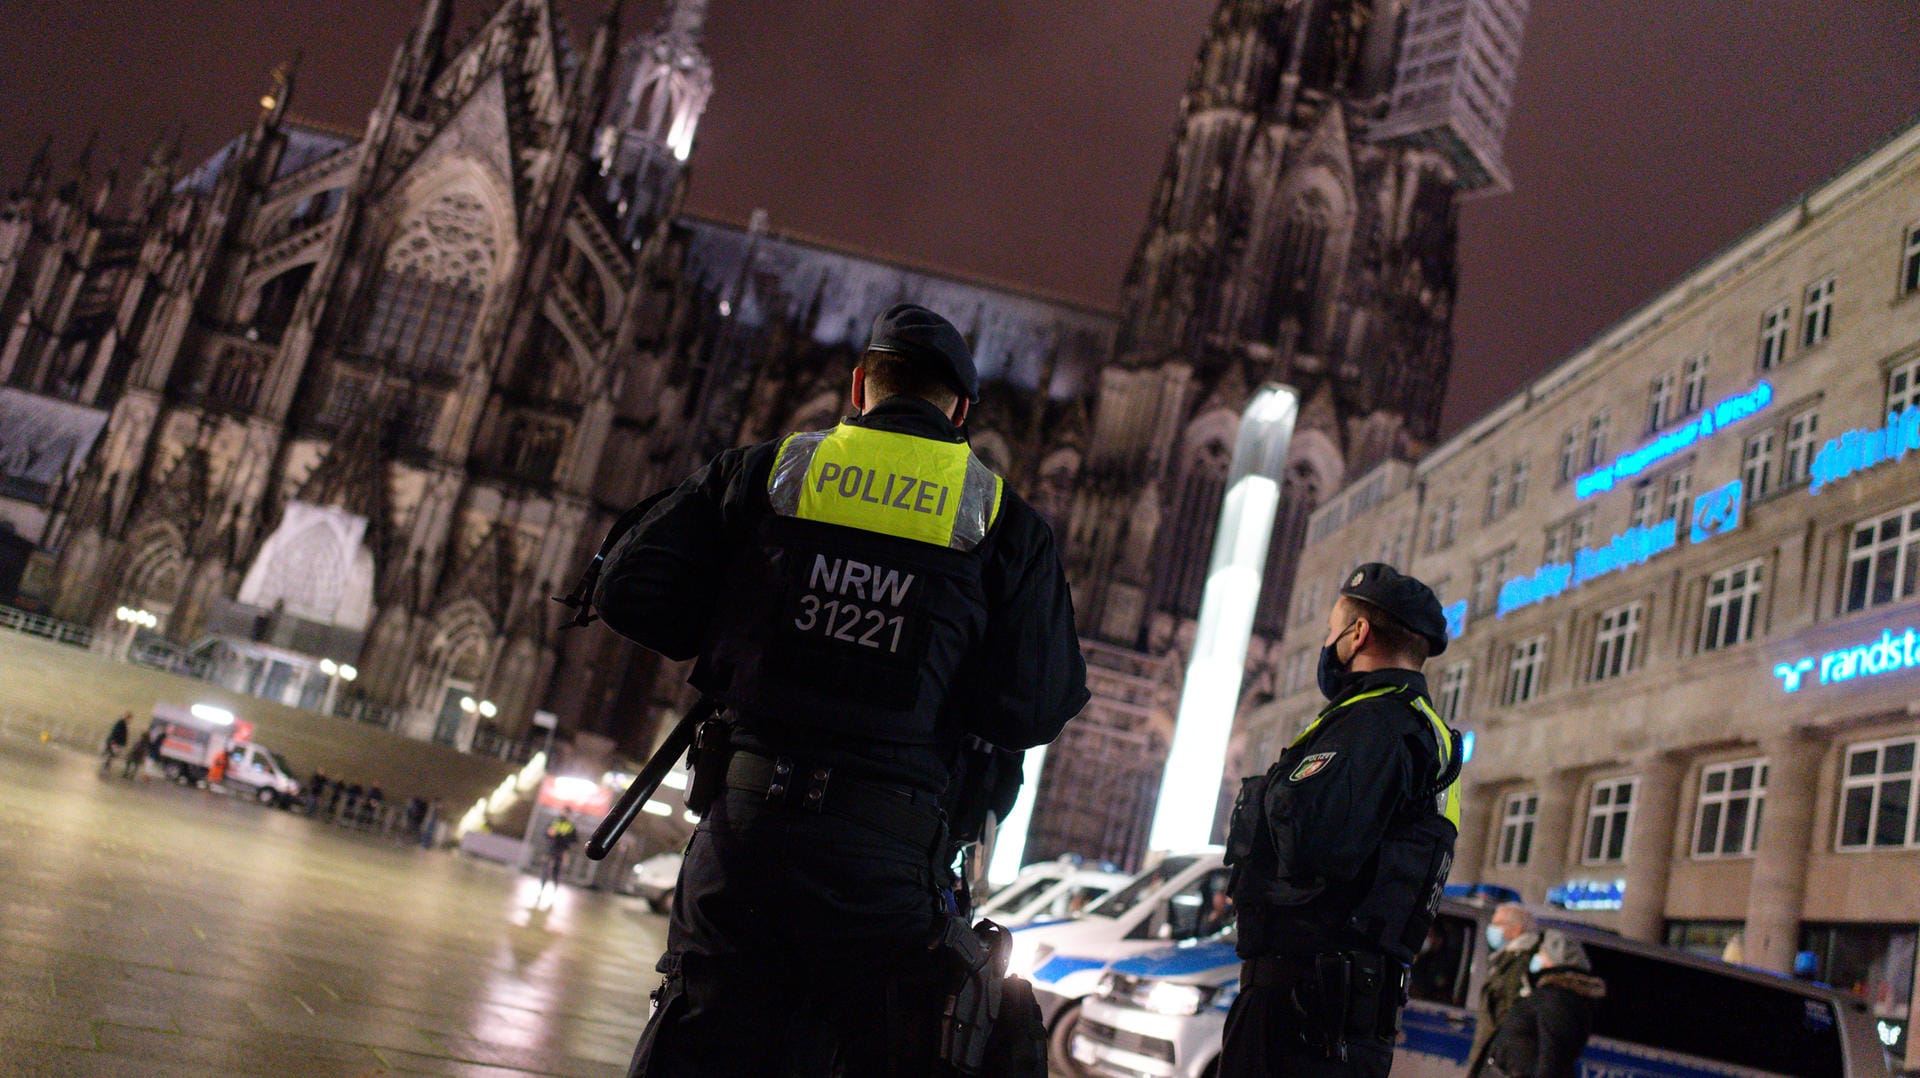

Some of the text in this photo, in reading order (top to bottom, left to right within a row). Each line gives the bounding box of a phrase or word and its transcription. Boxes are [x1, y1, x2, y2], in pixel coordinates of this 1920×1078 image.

[816, 462, 949, 517] POLIZEI
[809, 553, 915, 608] NRW
[794, 594, 905, 653] 31221
[1819, 626, 1920, 685] randst
